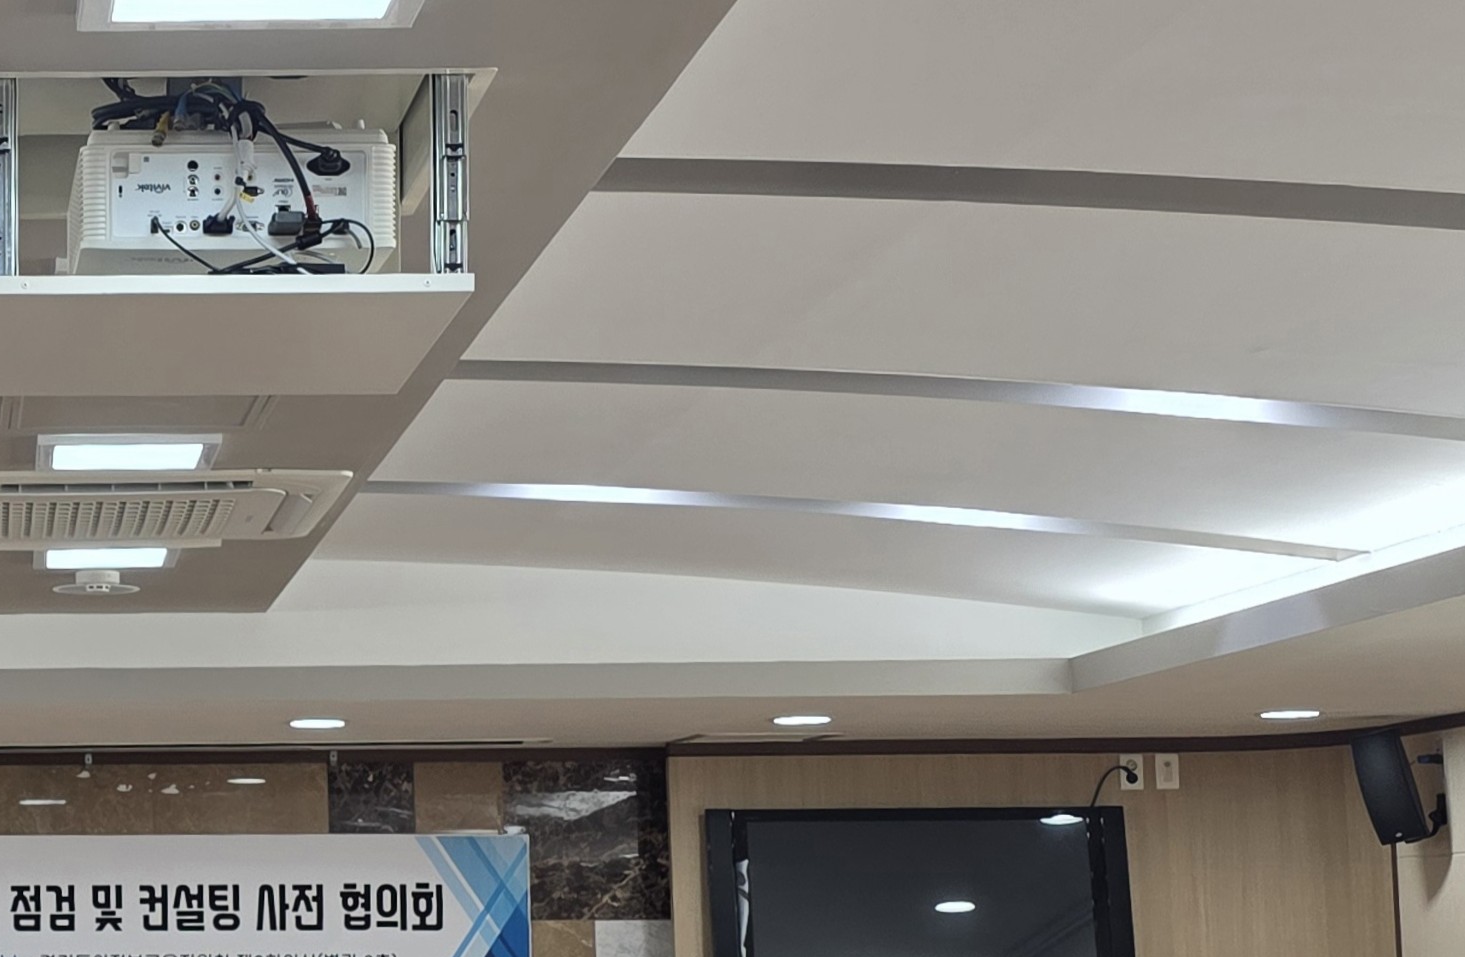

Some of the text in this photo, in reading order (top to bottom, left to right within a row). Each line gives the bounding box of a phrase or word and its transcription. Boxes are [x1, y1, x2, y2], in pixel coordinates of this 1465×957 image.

[10, 884, 76, 932] 점검
[91, 884, 123, 932] 및
[138, 883, 241, 932] 컨설팅
[256, 883, 324, 932] 사전
[339, 882, 444, 932] 협의회
